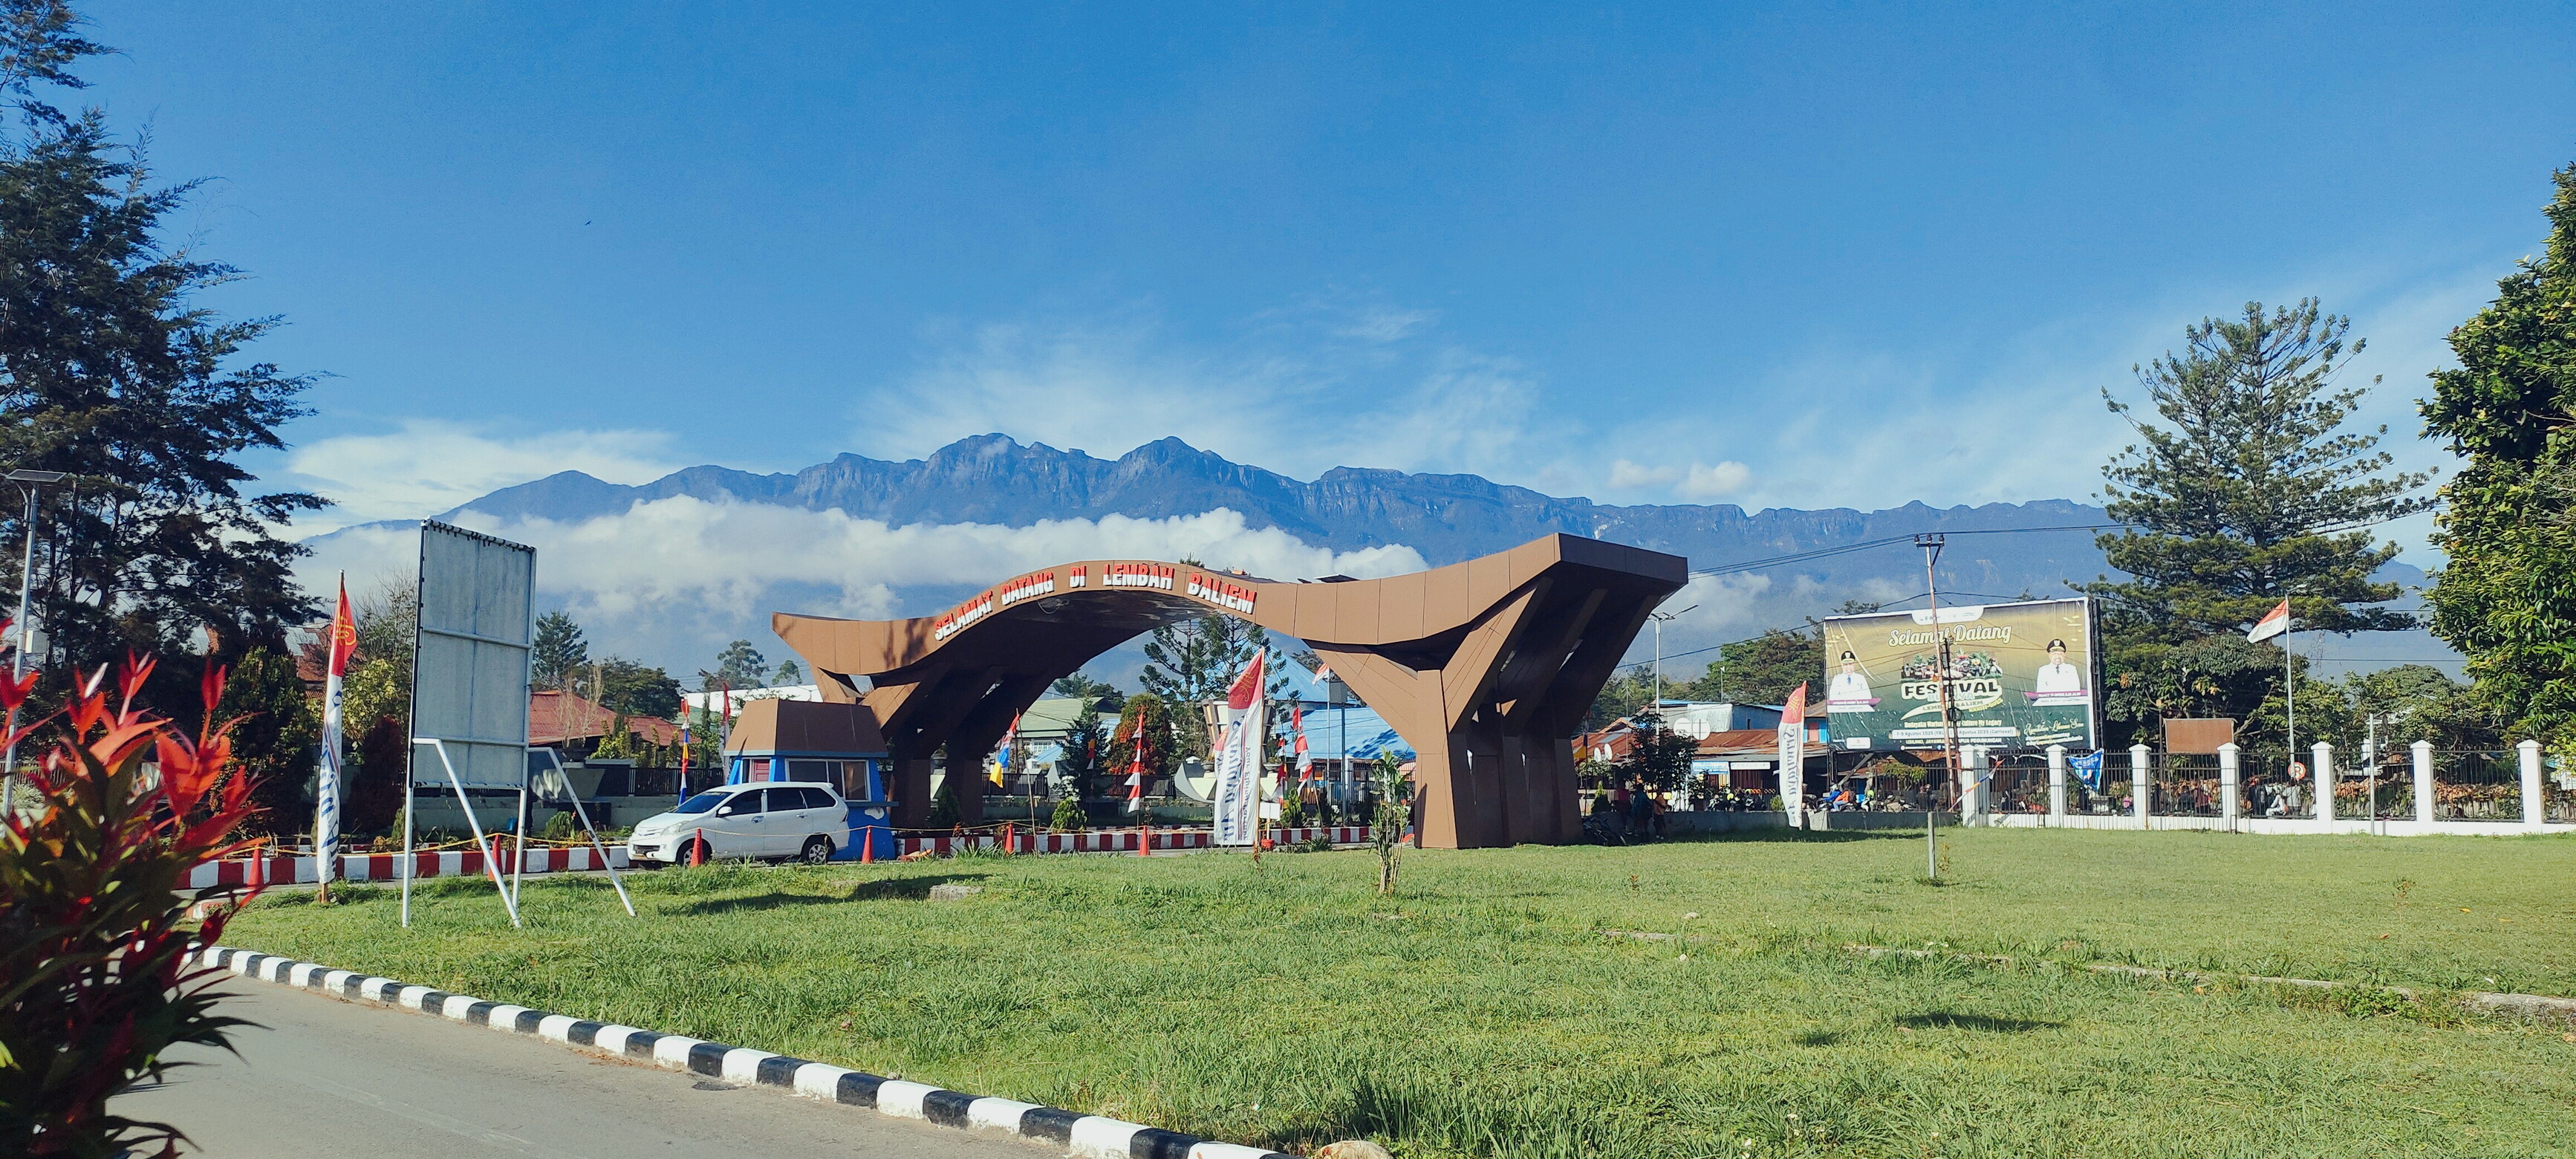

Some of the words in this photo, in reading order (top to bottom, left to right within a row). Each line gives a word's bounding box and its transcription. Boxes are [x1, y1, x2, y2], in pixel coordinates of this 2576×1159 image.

[934, 589, 993, 641] SELAMAT
[1001, 571, 1055, 606] DATANG
[1070, 565, 1087, 588] DI
[1103, 563, 1175, 591] LEMBAH
[1188, 572, 1258, 615] BALIEM
[1954, 624, 2013, 644] Datang
[1905, 682, 1998, 696] FESTVAL
